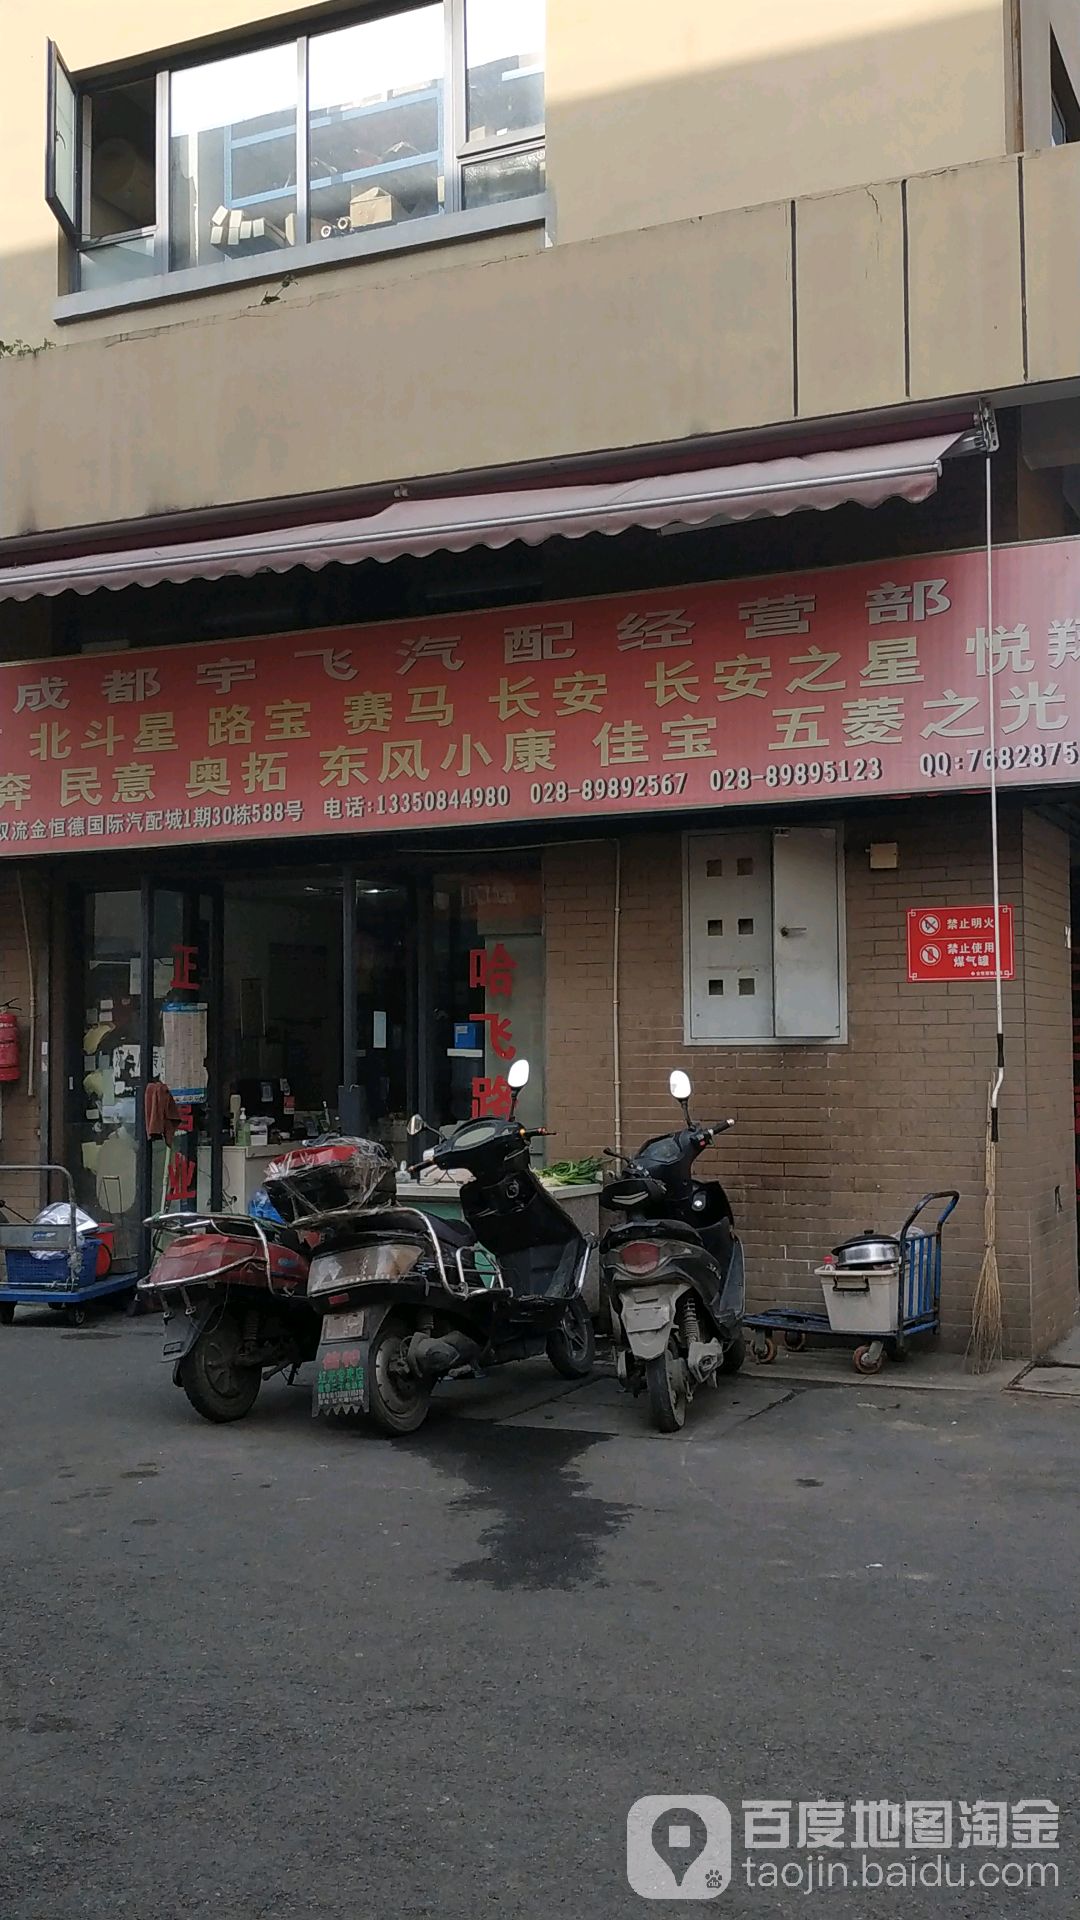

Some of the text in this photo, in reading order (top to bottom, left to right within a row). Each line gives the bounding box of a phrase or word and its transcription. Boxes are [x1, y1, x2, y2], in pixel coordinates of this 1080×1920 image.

[13, 579, 951, 713] 成都宇飞汽配经营部
[30, 712, 178, 761] 北斗星
[208, 699, 311, 747] 路宝
[344, 684, 453, 735] 赛马
[488, 671, 608, 721] 长安
[645, 636, 925, 708] 长安之星
[60, 762, 156, 807] 民意
[185, 752, 289, 798] 奥拓
[320, 728, 556, 787] 东风小康
[592, 714, 717, 767] 佳宝
[768, 682, 1069, 751] 五菱之光
[323, 785, 510, 820] 电话:13350844980
[530, 772, 687, 804] 028-89892567
[710, 756, 882, 791] 028-89895123
[946, 917, 995, 930] 禁止明火
[947, 942, 995, 955] 禁止使用
